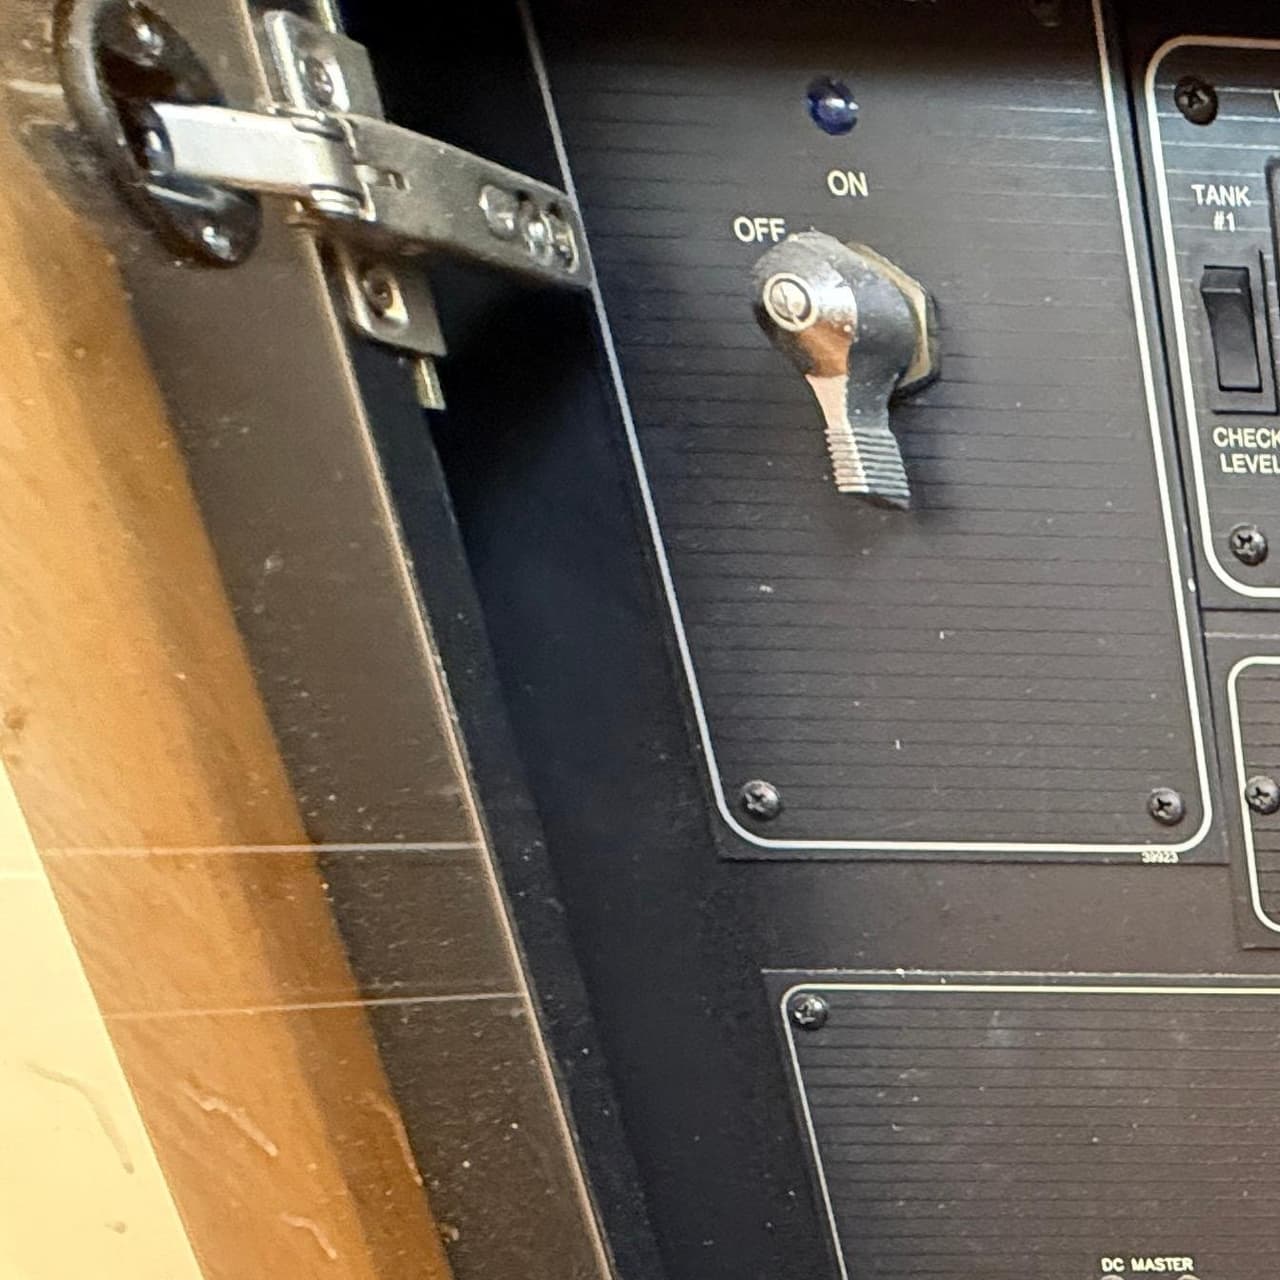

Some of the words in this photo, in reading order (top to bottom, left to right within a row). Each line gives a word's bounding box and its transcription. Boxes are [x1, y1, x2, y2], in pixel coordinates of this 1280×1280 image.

[828, 171, 869, 198] ON
[1191, 184, 1251, 207] TANK
[733, 216, 786, 244] OFF
[1213, 212, 1235, 232] #1
[1101, 1257, 1124, 1272] DC
[1131, 1257, 1194, 1272] MASTER
